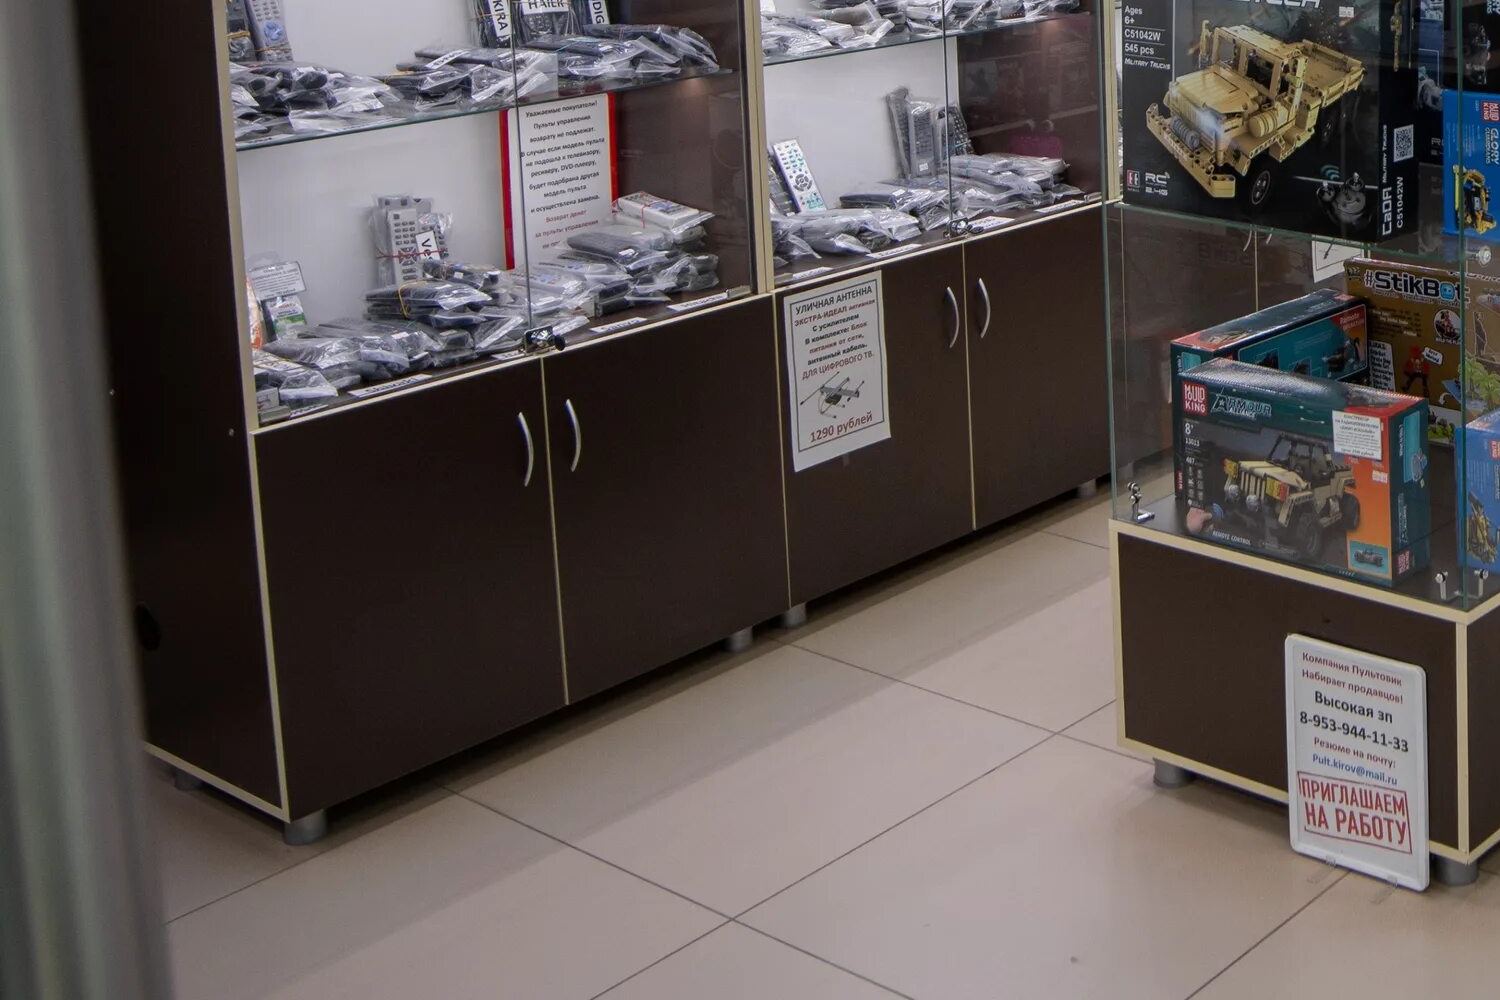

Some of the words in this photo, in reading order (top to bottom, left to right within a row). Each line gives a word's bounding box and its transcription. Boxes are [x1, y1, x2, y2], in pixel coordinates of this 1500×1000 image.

[1124, 5, 1143, 16] Ages
[1124, 16, 1135, 25] 6+
[1124, 29, 1161, 41] C51042W
[1124, 44, 1139, 53] 545
[1139, 46, 1155, 56] pcs
[533, 120, 556, 129] Пульты
[556, 115, 591, 126] управления
[795, 296, 834, 315] УЛИЧНАЯ
[836, 285, 873, 304] АНТЕННА
[794, 306, 848, 327] ЭКСТРА-ИДЕАЛ
[819, 313, 860, 332] усилителем
[811, 327, 850, 343] комплекте:
[801, 367, 818, 381] ДЛЯ
[819, 353, 863, 375] ЦИФРОВОГО
[807, 350, 842, 366] антенный
[1185, 400, 1206, 413] KING
[810, 424, 834, 443] 1290
[837, 412, 873, 437] рублей
[1302, 652, 1350, 673] Компания
[1351, 664, 1402, 687] Пультовик
[1302, 669, 1346, 689] Набирает
[1348, 682, 1404, 705] продавцов!
[1314, 690, 1374, 718] Высокая
[1377, 710, 1393, 724] зп
[1299, 711, 1409, 753] 8-953-944-11-33
[1313, 737, 1350, 755] Резюме
[1353, 748, 1364, 758] на
[1366, 750, 1397, 769] почту:
[1312, 753, 1398, 786] Pult.kirov@mail.ru
[1300, 777, 1405, 817] ПРИГЛАШАЕМ
[1305, 803, 1329, 830] НА
[1335, 809, 1407, 845] РАБОТУ
